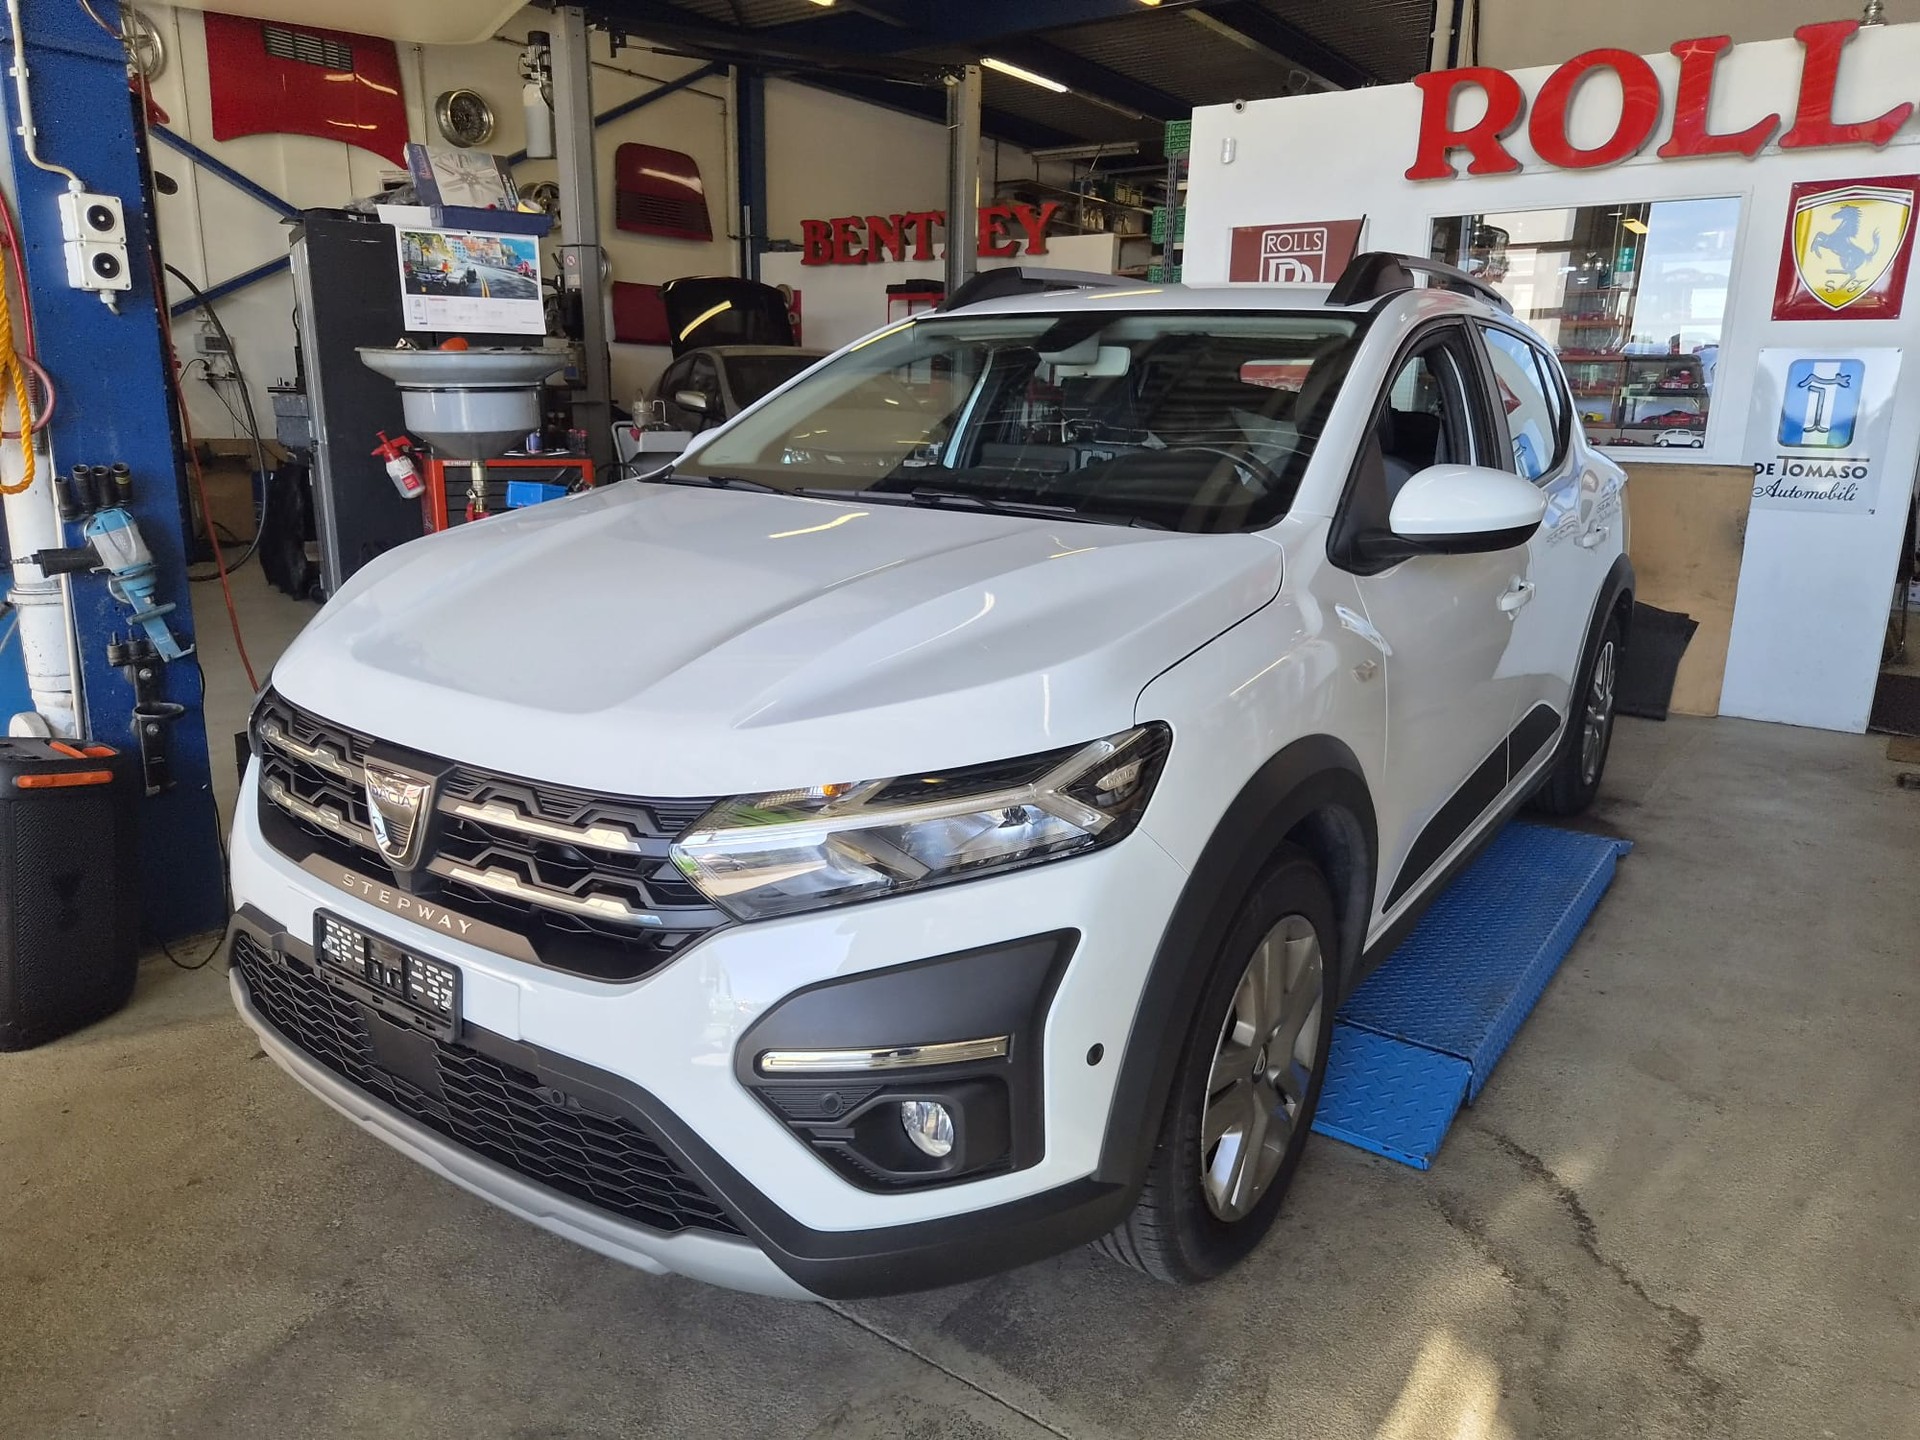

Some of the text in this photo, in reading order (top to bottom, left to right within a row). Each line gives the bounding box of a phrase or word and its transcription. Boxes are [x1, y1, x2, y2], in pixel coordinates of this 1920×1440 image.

[800, 201, 1062, 266] BENTEY
[1266, 232, 1322, 253] ROLLS
[1753, 455, 1870, 480] DE TOMASO
[1752, 479, 1859, 502] Automobili
[370, 785, 412, 808] DACIA
[342, 873, 472, 934] STEPWAY
